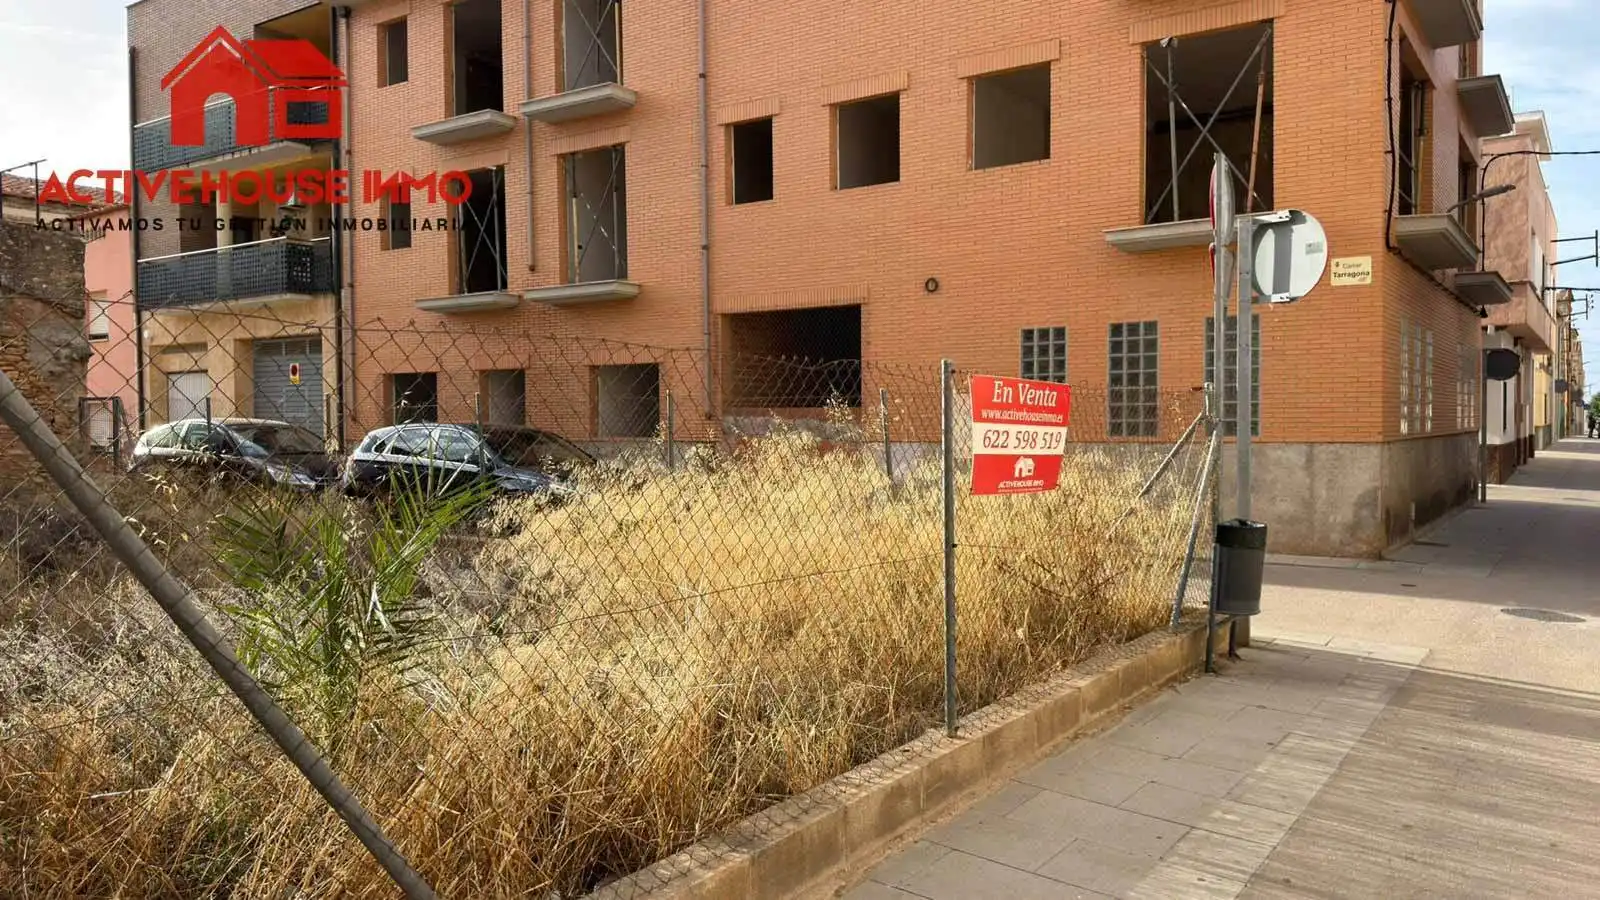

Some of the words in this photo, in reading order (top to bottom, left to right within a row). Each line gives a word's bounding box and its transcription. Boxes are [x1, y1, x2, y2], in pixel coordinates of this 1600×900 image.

[1333, 271, 1370, 279] Tarragona
[992, 380, 1013, 403] En
[1018, 383, 1058, 407] Venta
[983, 429, 1010, 449] 622
[1013, 430, 1038, 450] 598
[1040, 431, 1062, 450] 519
